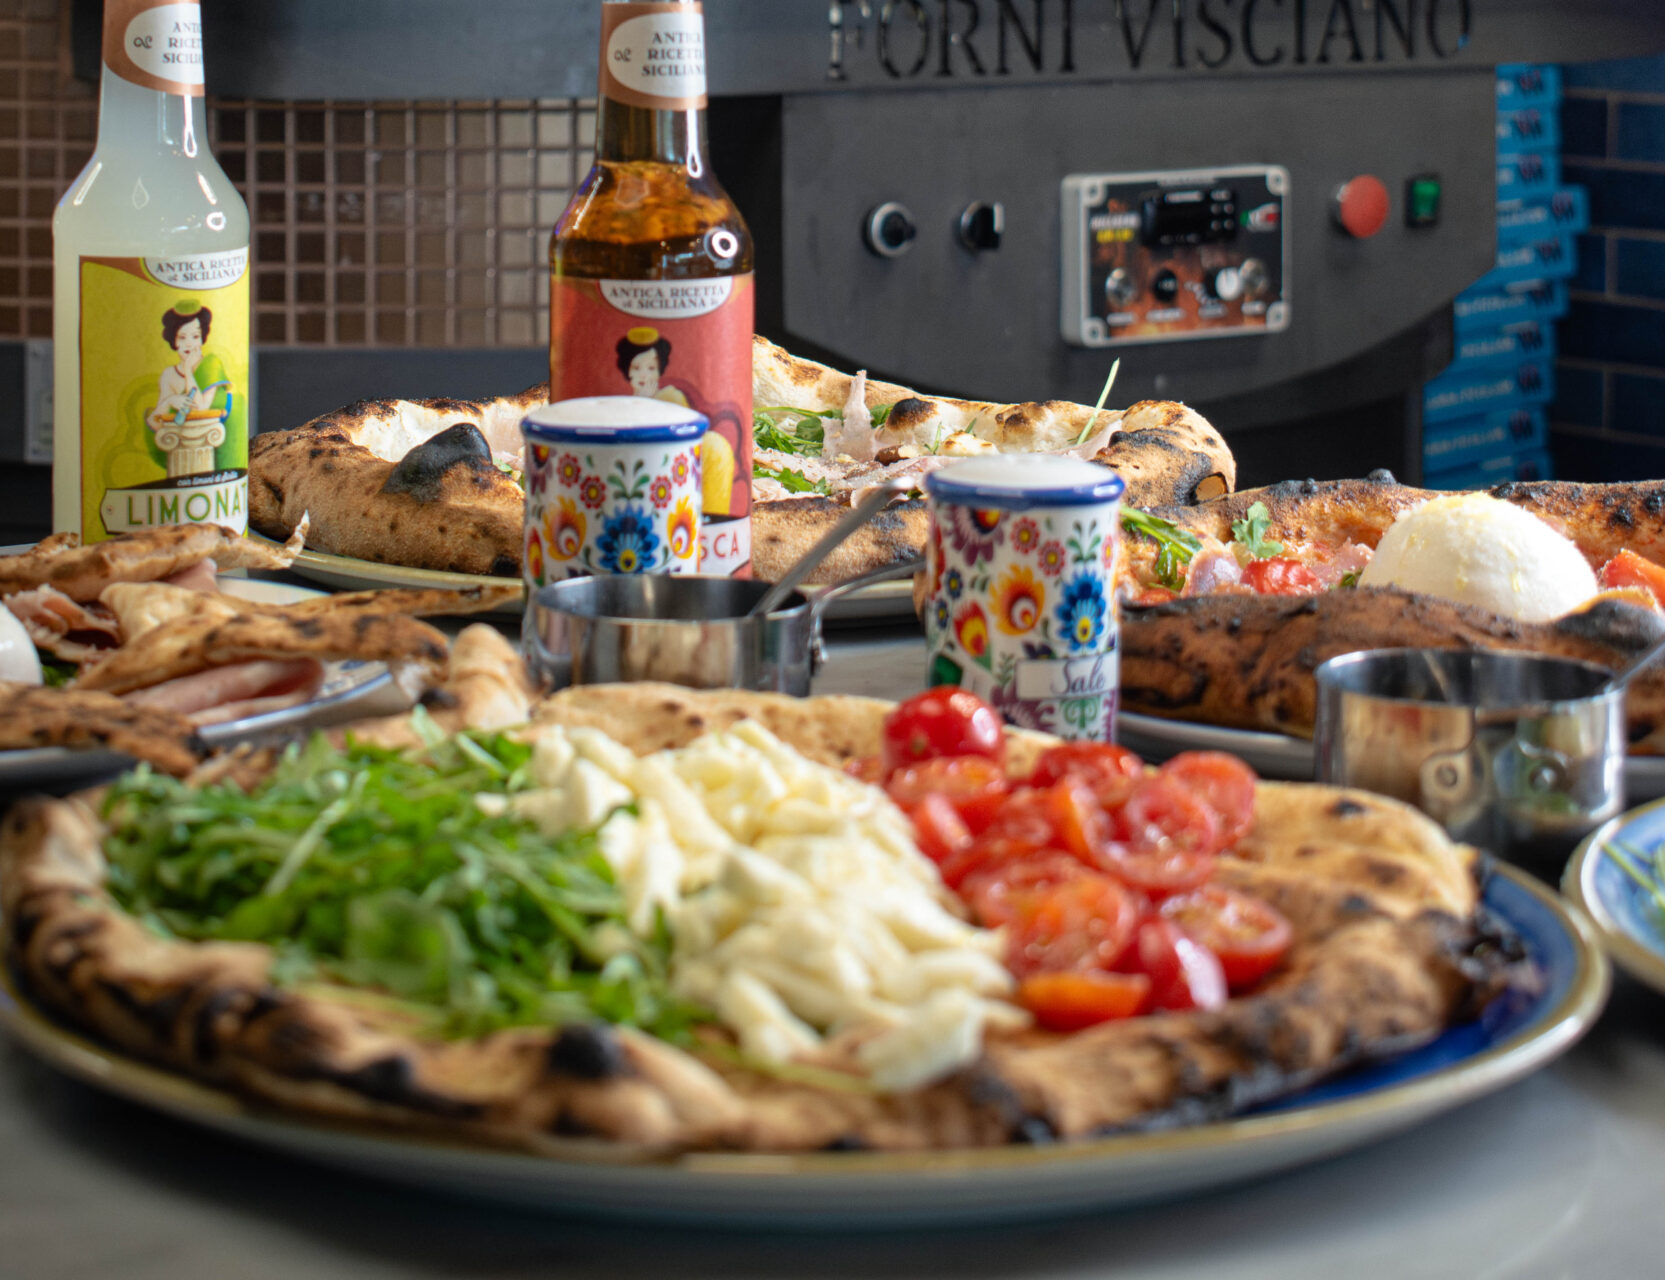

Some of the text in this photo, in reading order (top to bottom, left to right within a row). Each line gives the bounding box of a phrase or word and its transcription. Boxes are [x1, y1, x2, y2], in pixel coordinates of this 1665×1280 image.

[156, 261, 205, 273] ANTICA
[610, 285, 724, 298] ANTICA RICETTA
[637, 298, 706, 309] SICILIANA
[1050, 655, 1107, 694] Sale
